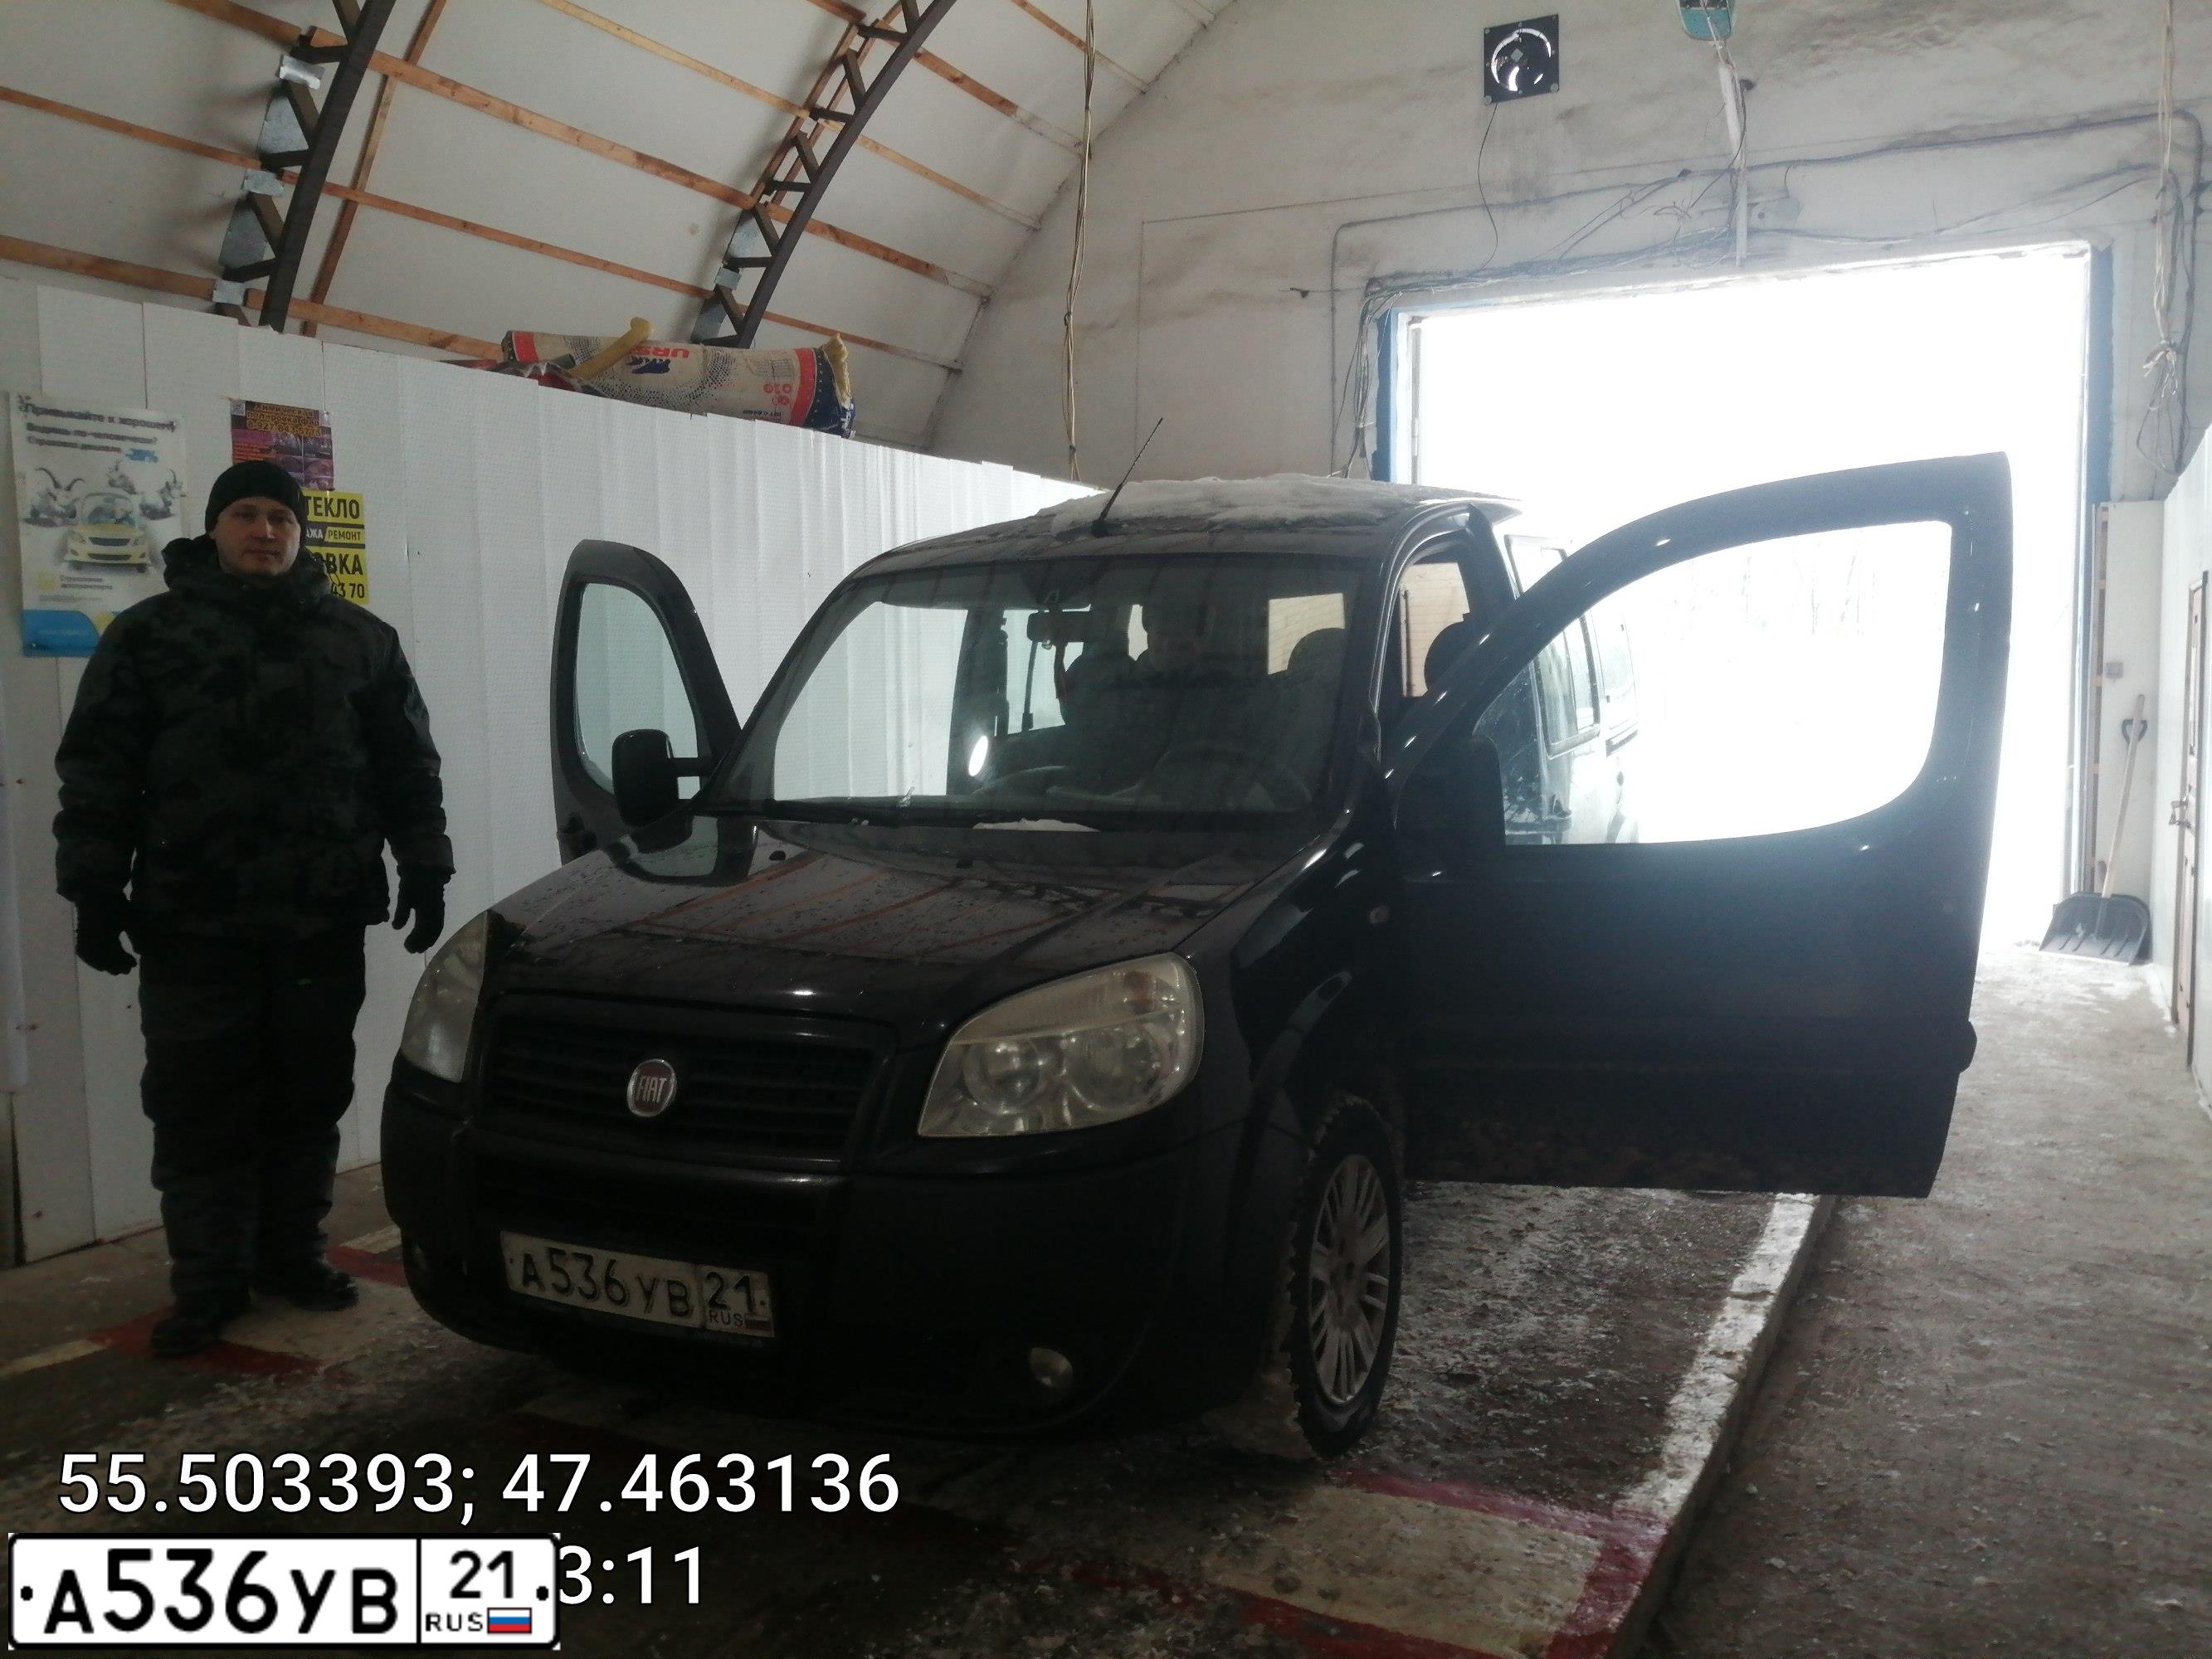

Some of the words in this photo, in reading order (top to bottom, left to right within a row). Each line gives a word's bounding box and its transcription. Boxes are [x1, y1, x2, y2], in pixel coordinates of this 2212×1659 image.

[631, 345, 690, 360] URS
[300, 495, 360, 520] ТЕКЛО
[328, 529, 362, 541] РЕМОНТ
[348, 582, 365, 599] 70
[636, 1078, 667, 1104] FIAT
[706, 1272, 757, 1312] 21
[709, 1310, 744, 1327] RUS
